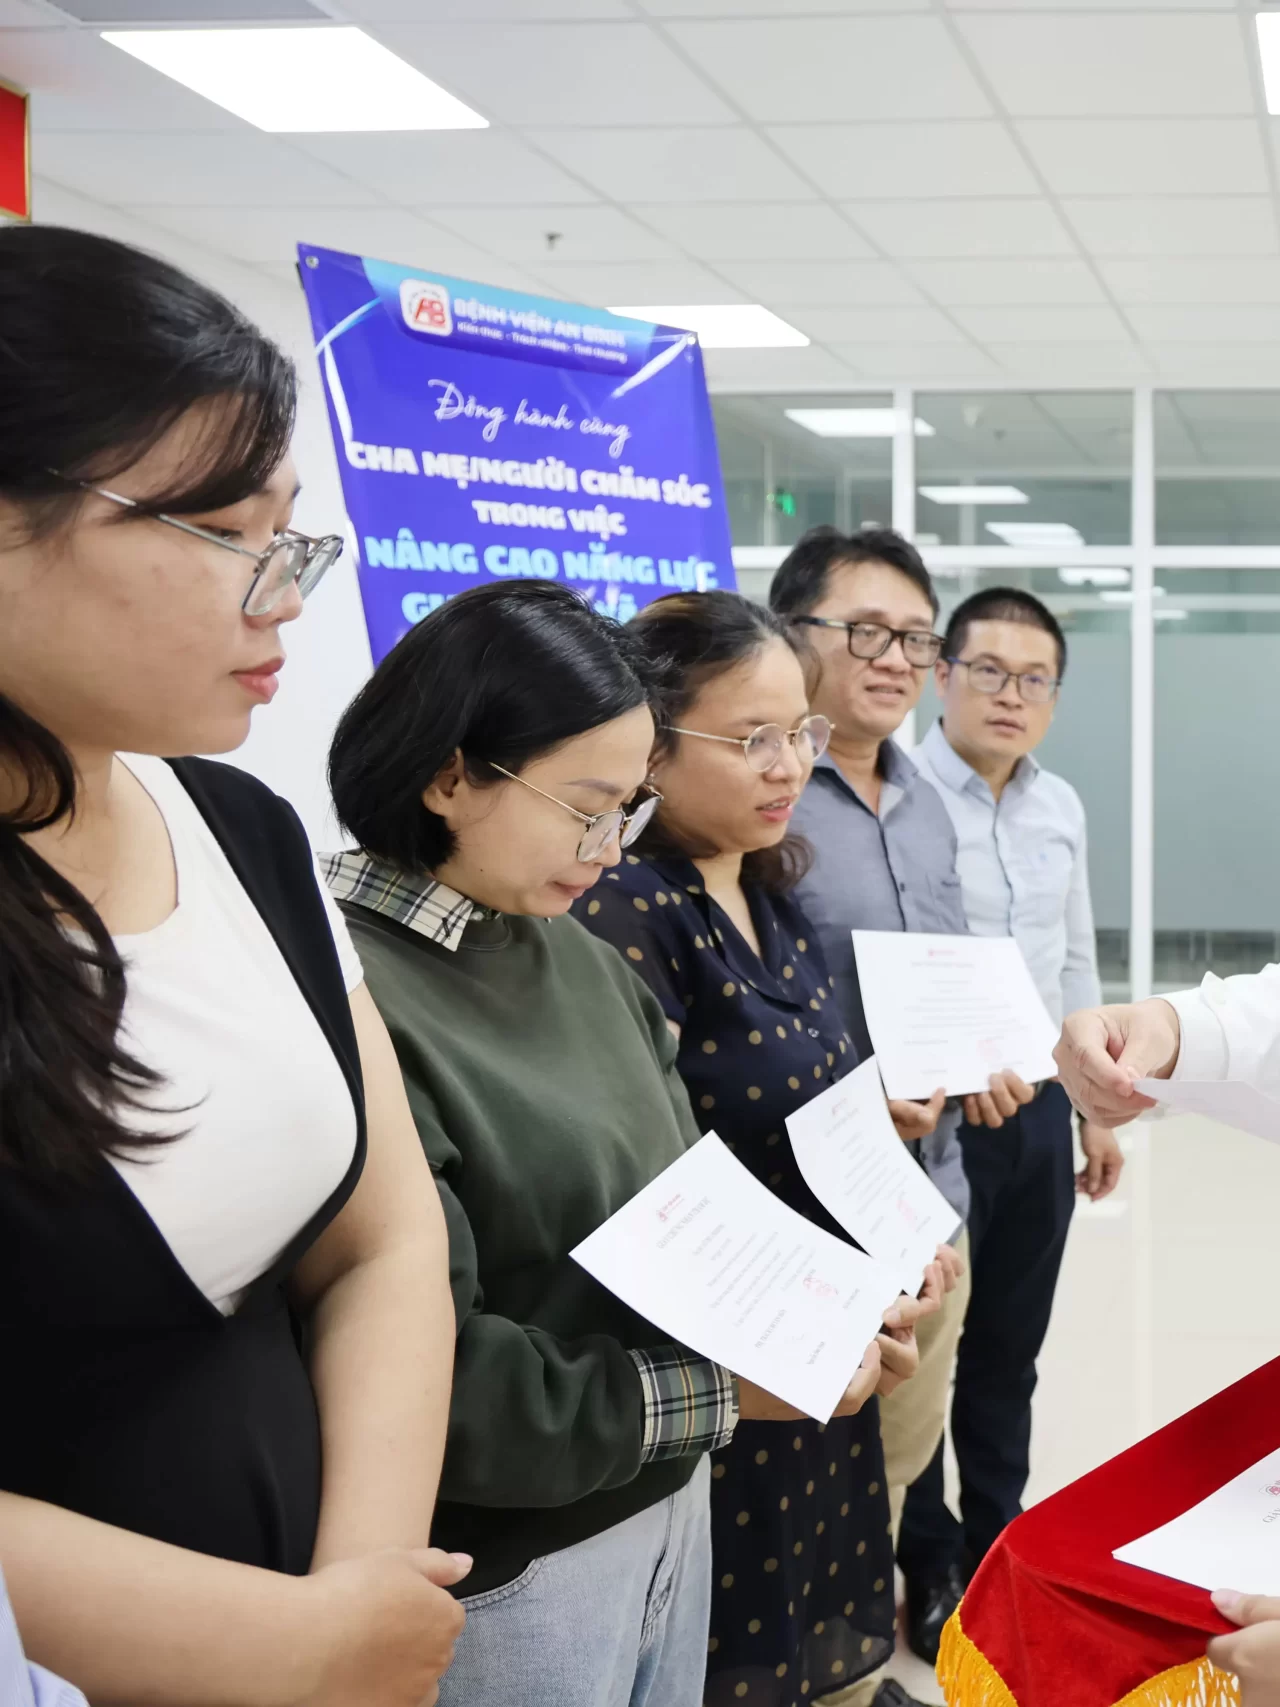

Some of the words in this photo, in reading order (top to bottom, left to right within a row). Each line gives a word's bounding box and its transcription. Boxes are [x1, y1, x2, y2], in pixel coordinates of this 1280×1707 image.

[509, 309, 552, 334] VIỆN
[554, 319, 581, 339] AN
[427, 379, 509, 442] Đồng
[514, 399, 574, 430] hành
[580, 416, 632, 460] cùng
[345, 441, 419, 475] CHA
[421, 451, 578, 493] MẸ/NGƯỜI
[580, 465, 661, 502] CHĂM
[661, 473, 712, 509] SÓC
[471, 499, 567, 531] TRONG
[567, 503, 627, 541] VIỆC
[364, 528, 479, 573] NÂNG
[484, 545, 559, 579] CAO
[562, 542, 656, 584] NĂNG
[658, 555, 719, 592] LỰC
